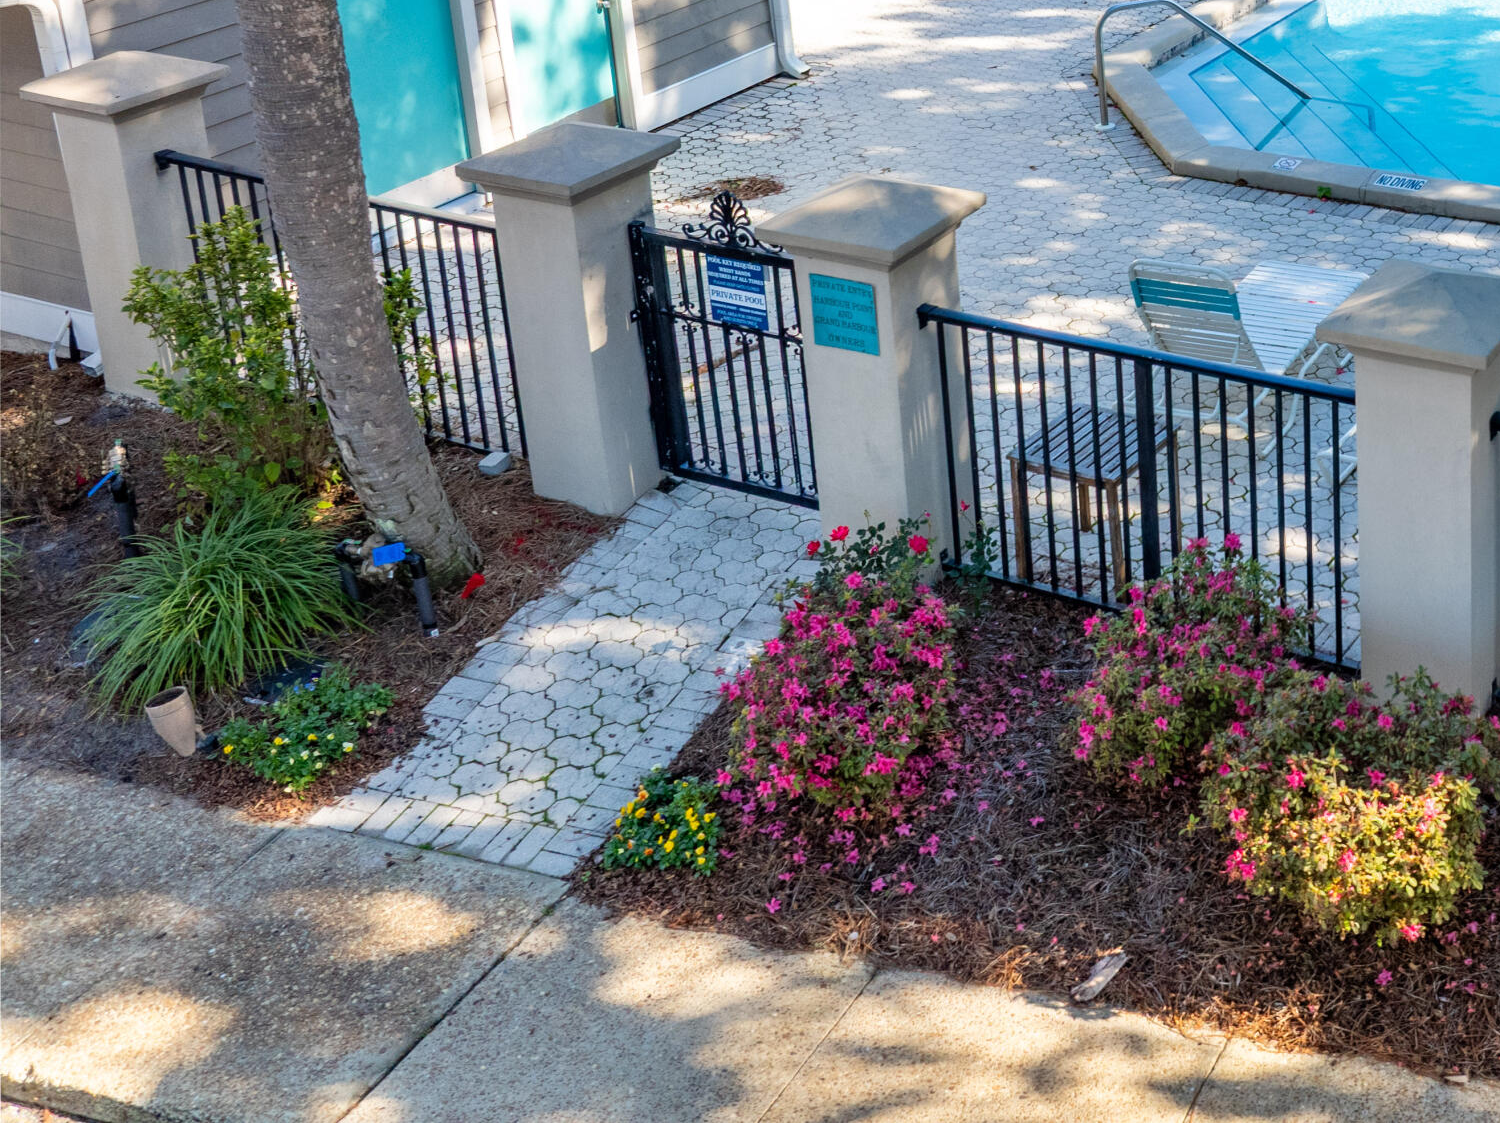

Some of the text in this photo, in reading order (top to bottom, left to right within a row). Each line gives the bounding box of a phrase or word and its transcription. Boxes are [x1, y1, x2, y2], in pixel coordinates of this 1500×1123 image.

[1376, 174, 1426, 191] NO DIVING
[707, 256, 722, 265] POOL
[812, 278, 847, 292] PRIVATE
[711, 289, 765, 306] PRIVATE POOL
[838, 310, 853, 320] AND
[828, 333, 865, 348] OWNERS
